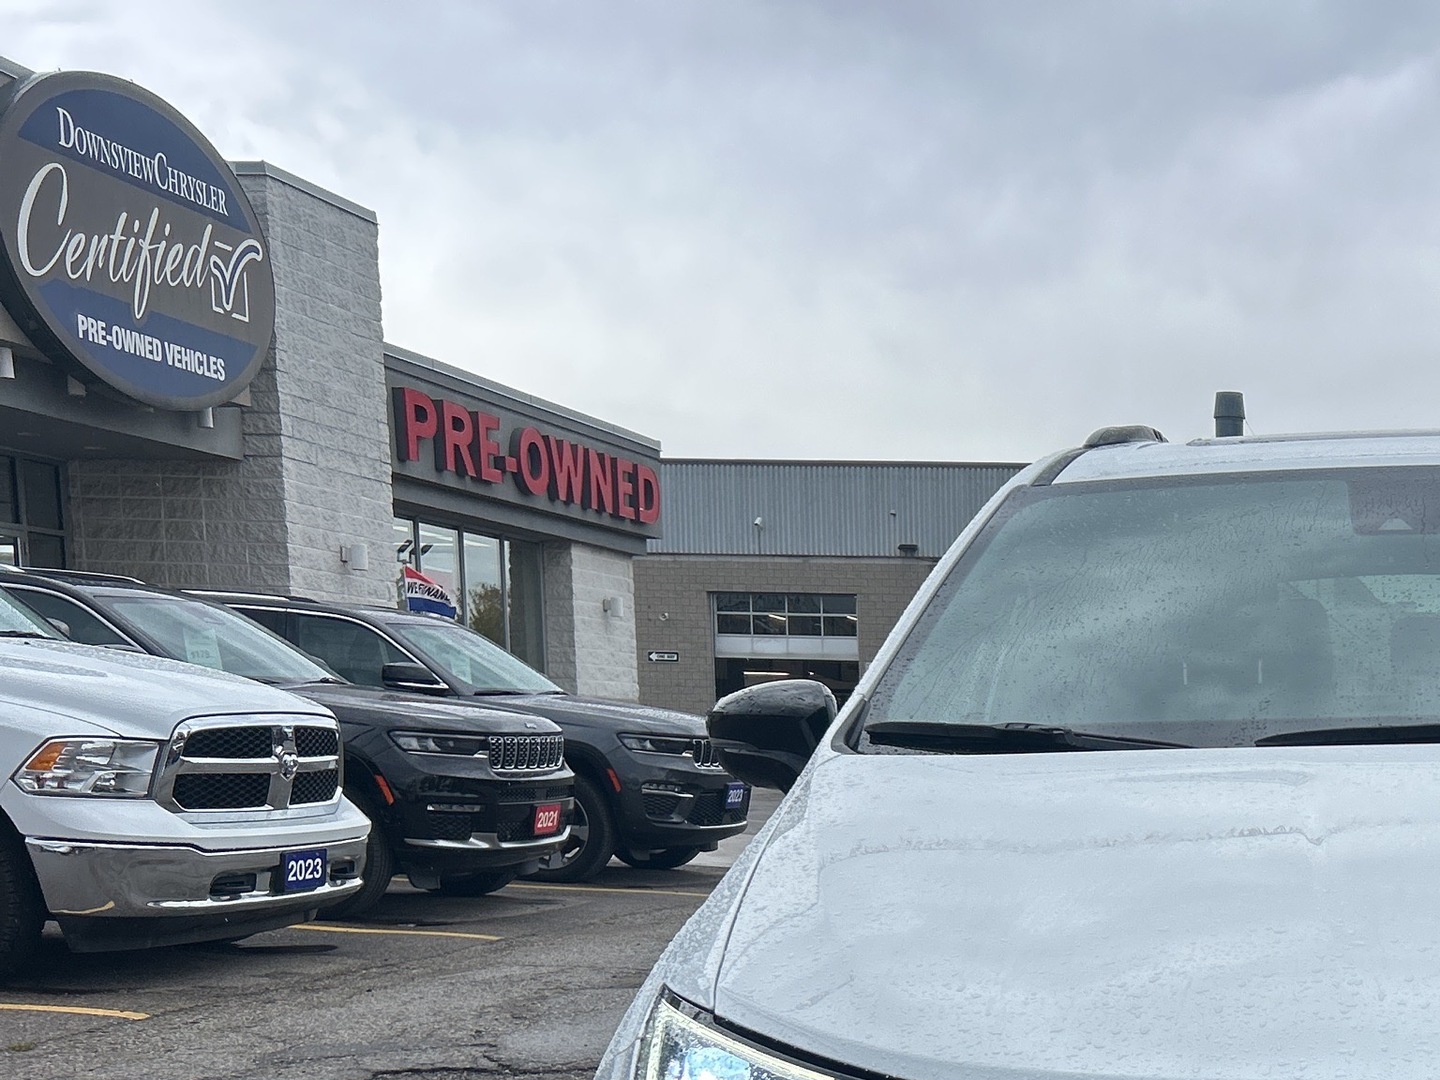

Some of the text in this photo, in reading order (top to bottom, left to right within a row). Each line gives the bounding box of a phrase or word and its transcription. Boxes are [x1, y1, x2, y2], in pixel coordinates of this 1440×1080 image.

[17, 162, 214, 320] Certified
[77, 314, 226, 382] PRE-OWNED VEHICLES
[393, 386, 660, 525] PRE-OWNED
[537, 810, 559, 828] 2021
[287, 857, 322, 882] 2023
